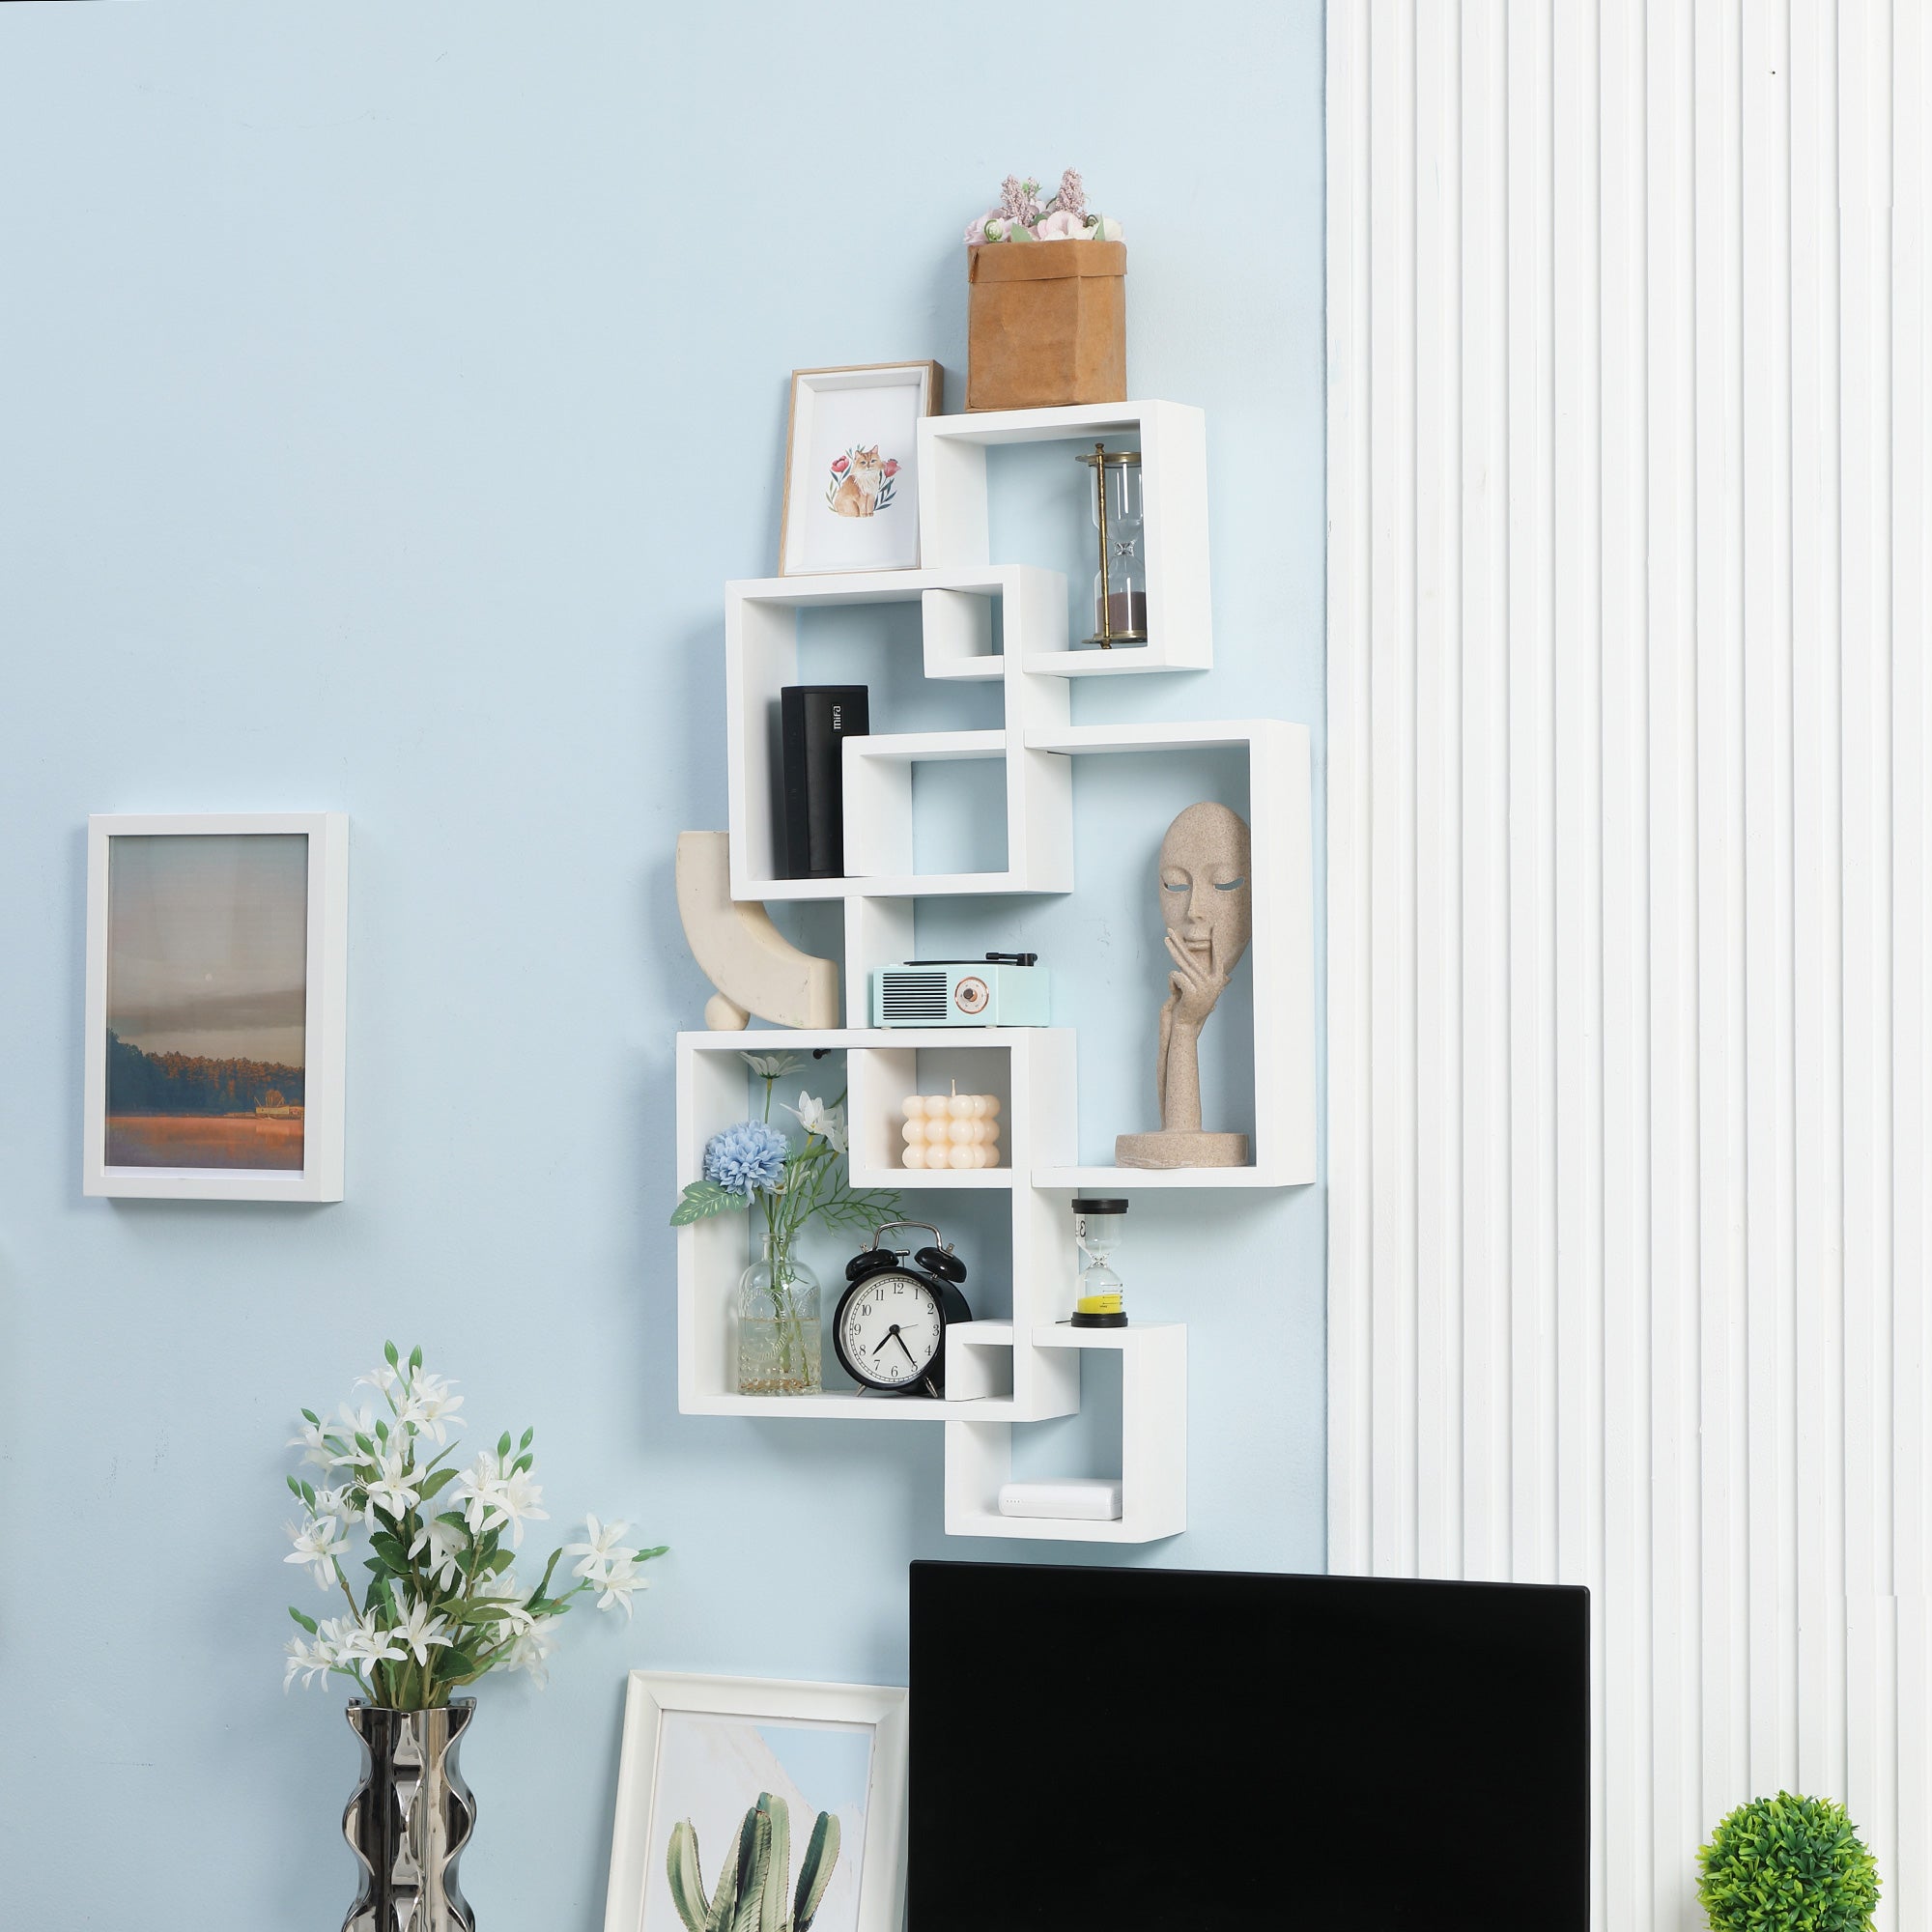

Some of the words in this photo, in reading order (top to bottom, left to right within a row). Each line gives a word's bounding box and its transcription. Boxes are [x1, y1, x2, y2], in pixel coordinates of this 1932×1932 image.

[893, 1283, 904, 1294] 12
[914, 1289, 919, 1299] 1
[875, 1290, 884, 1300] 11
[862, 1304, 871, 1316] 10
[927, 1303, 934, 1315] 2
[854, 1323, 862, 1335] 9
[932, 1324, 939, 1336] 3
[859, 1345, 867, 1356] 8
[924, 1345, 932, 1356] 4
[873, 1359, 881, 1371] 7
[911, 1361, 919, 1372] 5
[891, 1366, 898, 1377] 6
